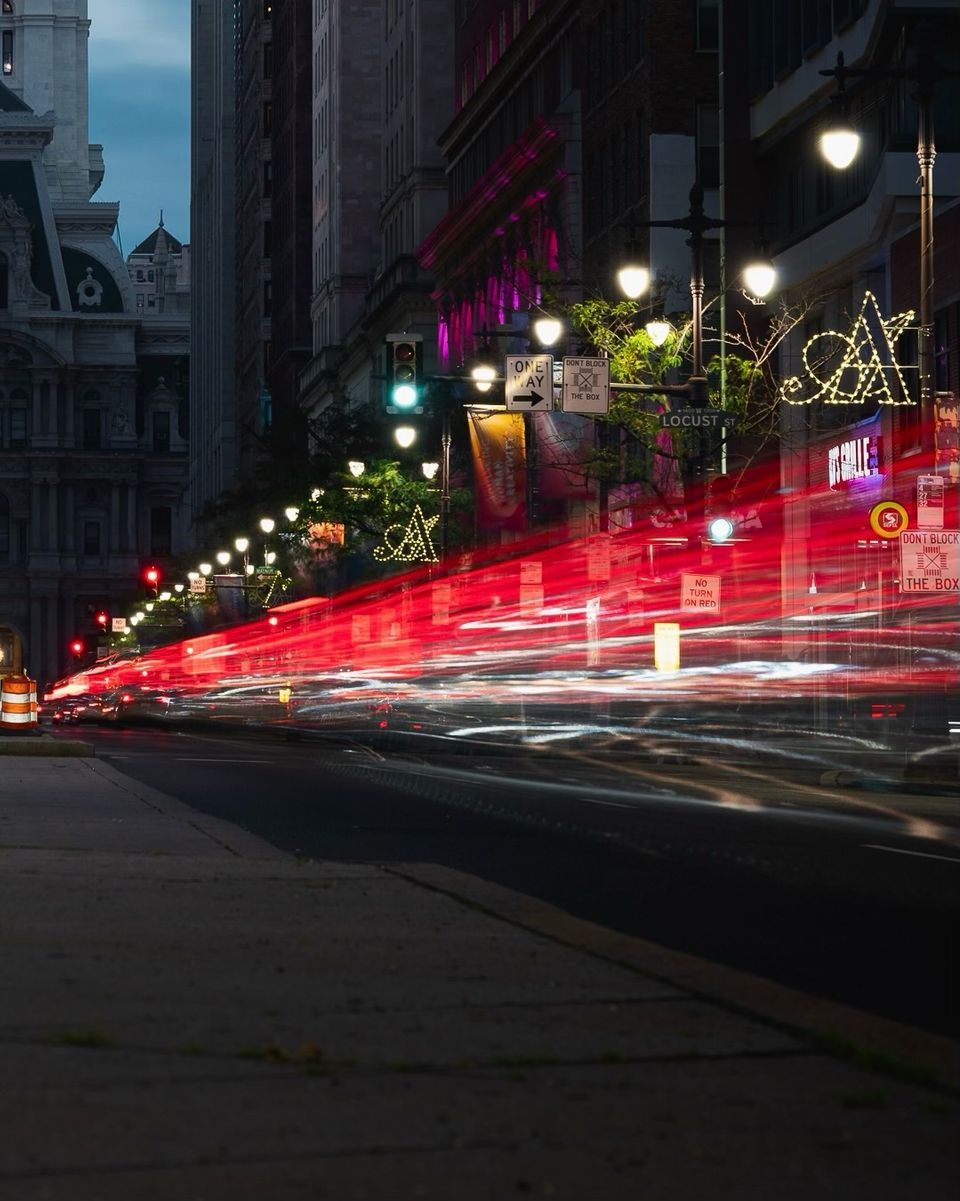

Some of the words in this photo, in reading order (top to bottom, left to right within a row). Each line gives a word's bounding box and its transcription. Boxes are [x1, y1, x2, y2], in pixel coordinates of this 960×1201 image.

[514, 360, 544, 373] ONE
[513, 375, 544, 388] WAY
[586, 393, 600, 401] BOX
[663, 415, 719, 427] LOCUST
[724, 418, 736, 426] ST
[930, 533, 960, 545] BLOCK
[695, 578, 708, 588] NO
[906, 577, 929, 590] THE
[935, 578, 960, 590] BOX
[689, 588, 713, 599] TURN
[684, 598, 697, 606] ON
[699, 599, 717, 608] RED
